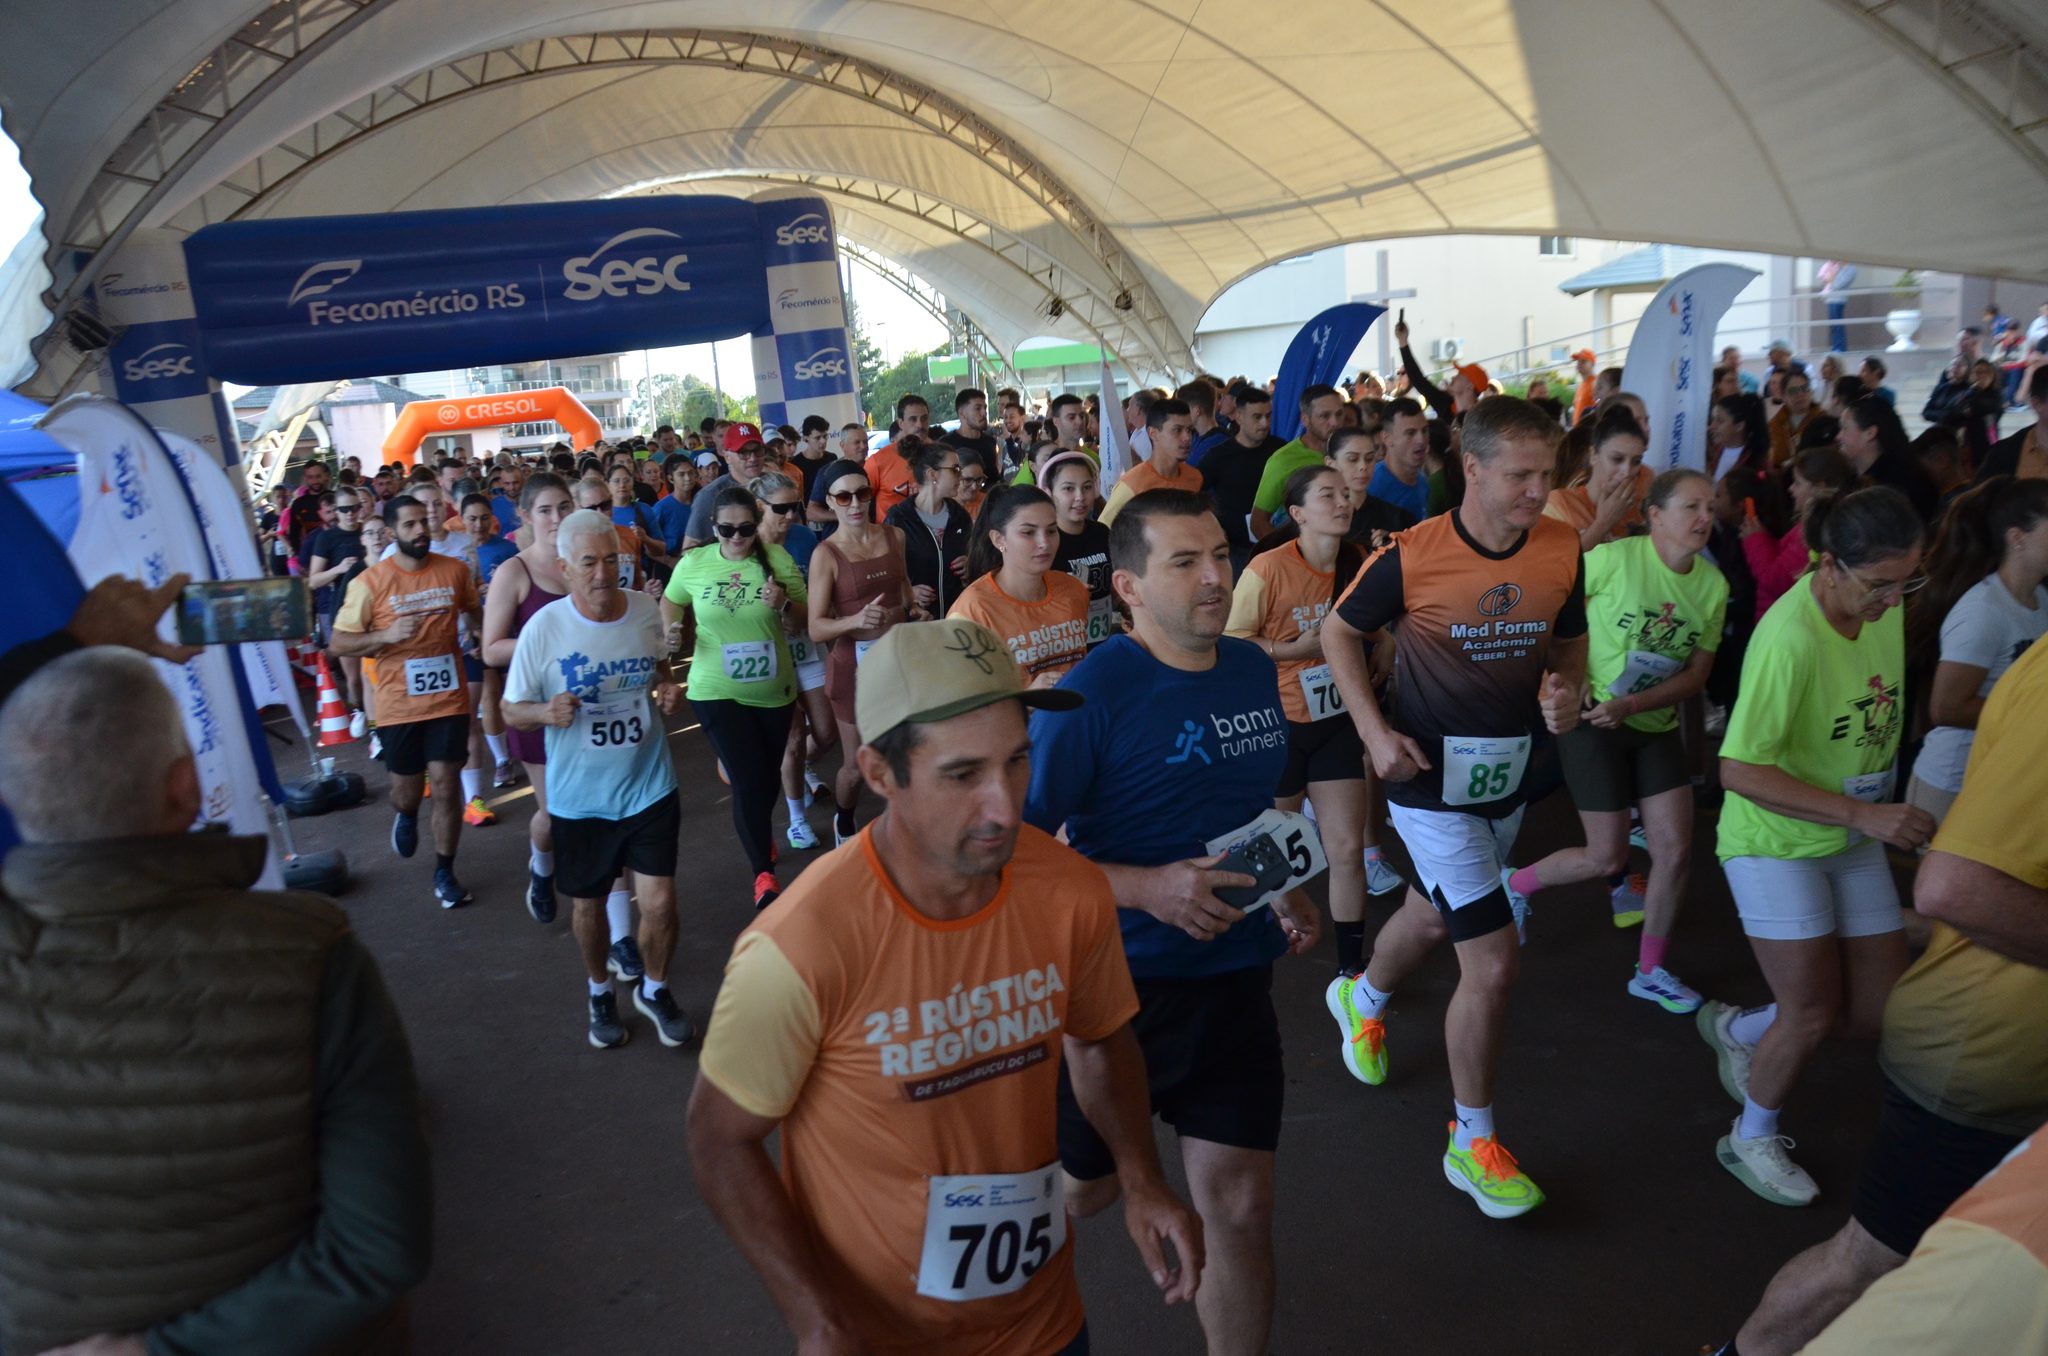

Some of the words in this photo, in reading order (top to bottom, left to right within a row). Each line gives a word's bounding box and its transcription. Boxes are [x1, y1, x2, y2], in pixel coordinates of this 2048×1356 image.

[308, 289, 479, 325] Fecomércio
[486, 283, 526, 310] RS
[465, 398, 543, 419] CRESOL
[1450, 622, 1490, 639] Med
[1494, 620, 1547, 635] Forma
[1462, 637, 1537, 651] Academia
[730, 656, 770, 680] 222
[1471, 651, 1506, 662] SEBERI
[414, 669, 451, 692] 529
[591, 716, 643, 747] 503
[1210, 706, 1280, 739] banri
[1221, 729, 1286, 758] runners
[1468, 762, 1512, 798] 85
[864, 1006, 910, 1045] 2ª
[919, 963, 1065, 1036] RÚSTICA
[880, 1000, 1061, 1077] REGIONAL
[915, 1082, 934, 1097] DE
[949, 1212, 1051, 1289] 705
